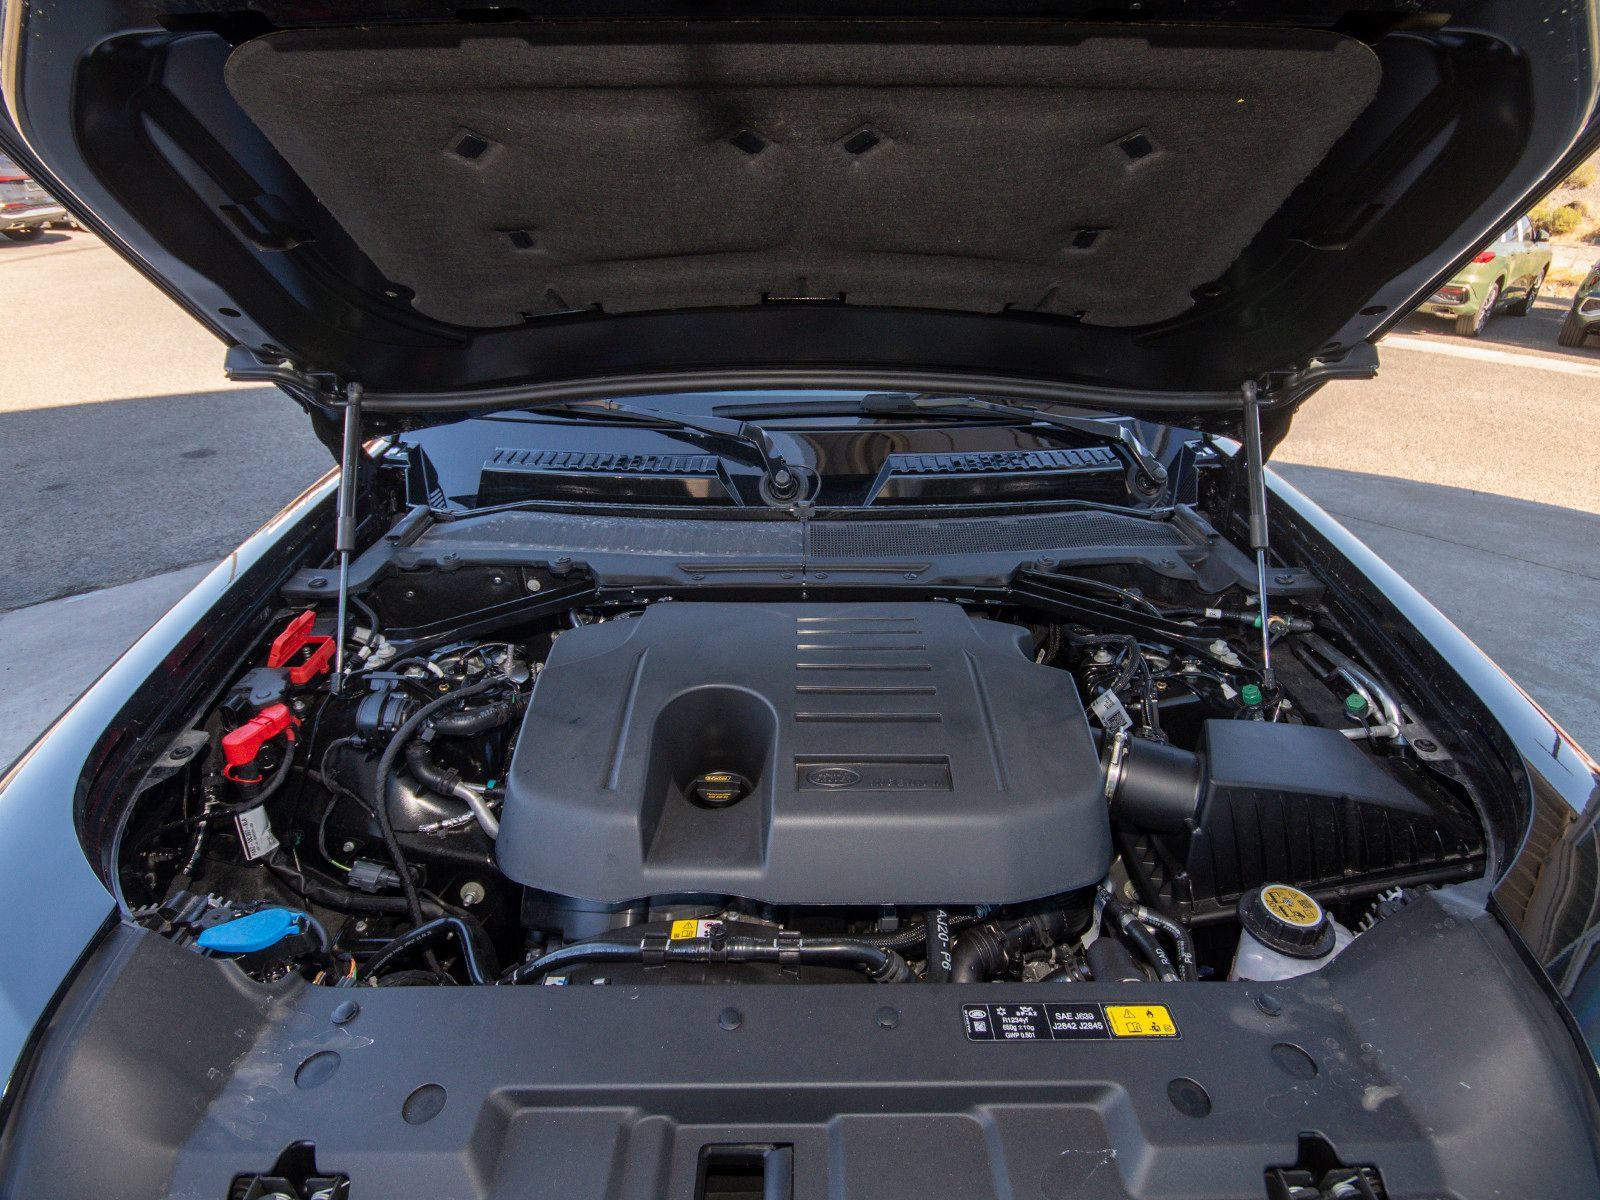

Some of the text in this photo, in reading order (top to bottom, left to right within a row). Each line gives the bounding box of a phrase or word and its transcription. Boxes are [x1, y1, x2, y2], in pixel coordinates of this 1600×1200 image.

[940, 951, 952, 971] P6
[1055, 1012, 1073, 1020] SAE
[1053, 1022, 1104, 1030] J2842 J2845
